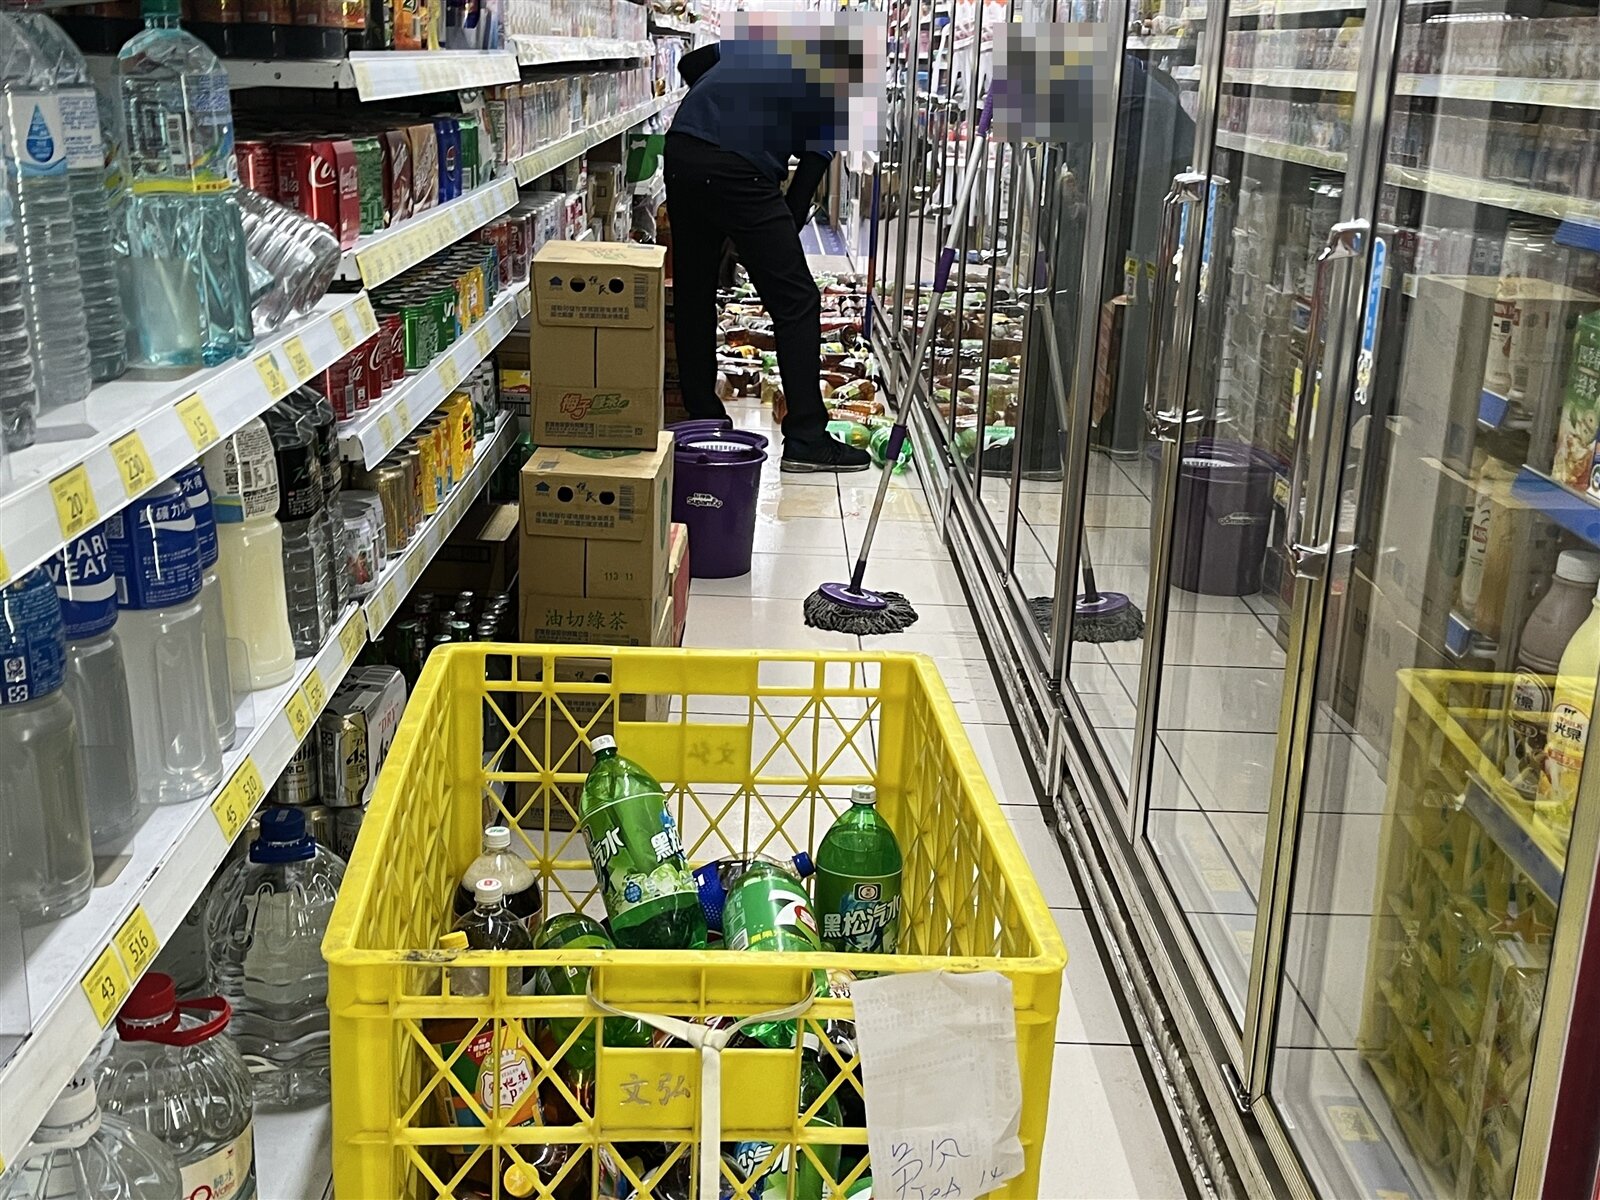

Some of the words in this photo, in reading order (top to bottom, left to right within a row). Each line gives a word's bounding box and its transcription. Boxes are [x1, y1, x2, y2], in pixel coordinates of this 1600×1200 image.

[66, 492, 83, 520] 20
[545, 609, 628, 631] 油切綠茶
[1554, 721, 1583, 742] 光泉
[243, 781, 258, 801] 510
[226, 804, 238, 825] 45
[823, 895, 902, 938] 黑松汽水
[129, 930, 149, 963] 516
[101, 976, 116, 1001] 43
